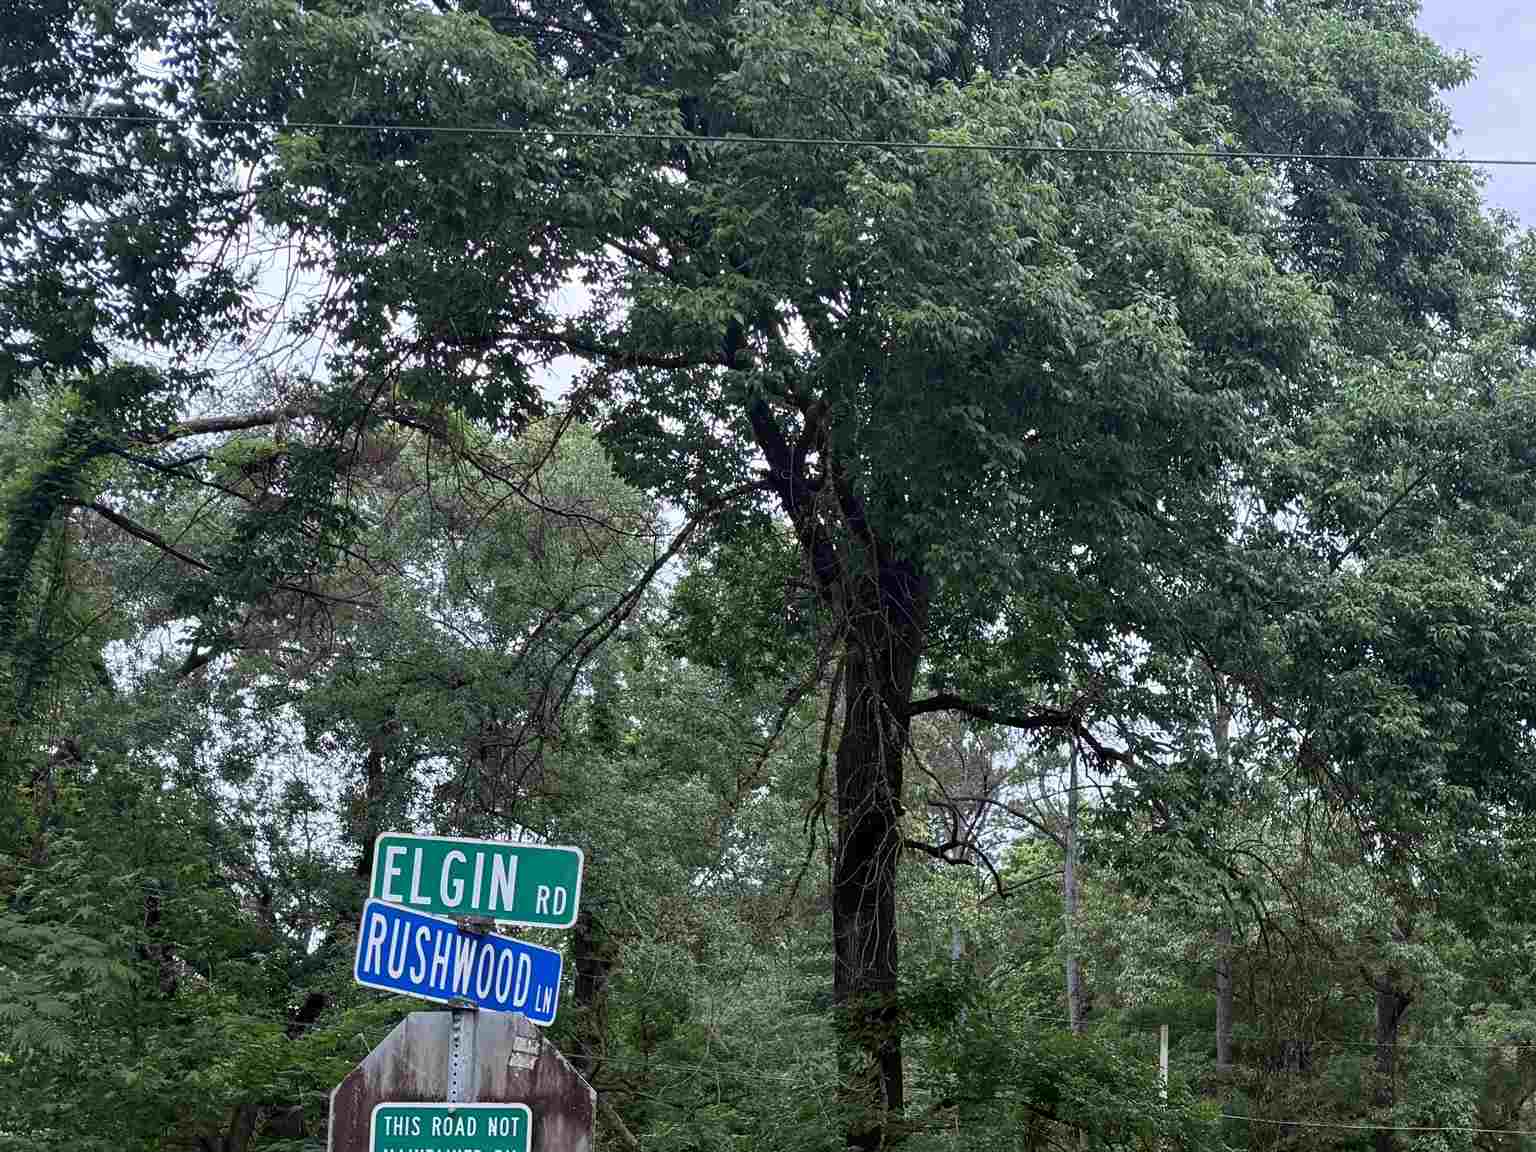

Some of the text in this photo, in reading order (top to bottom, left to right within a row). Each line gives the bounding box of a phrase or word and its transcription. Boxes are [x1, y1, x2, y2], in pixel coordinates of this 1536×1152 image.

[382, 846, 567, 916] ELGIN RD
[363, 913, 553, 1013] RUSHWOOD LN
[384, 1116, 519, 1137] THIS ROAD NOT
